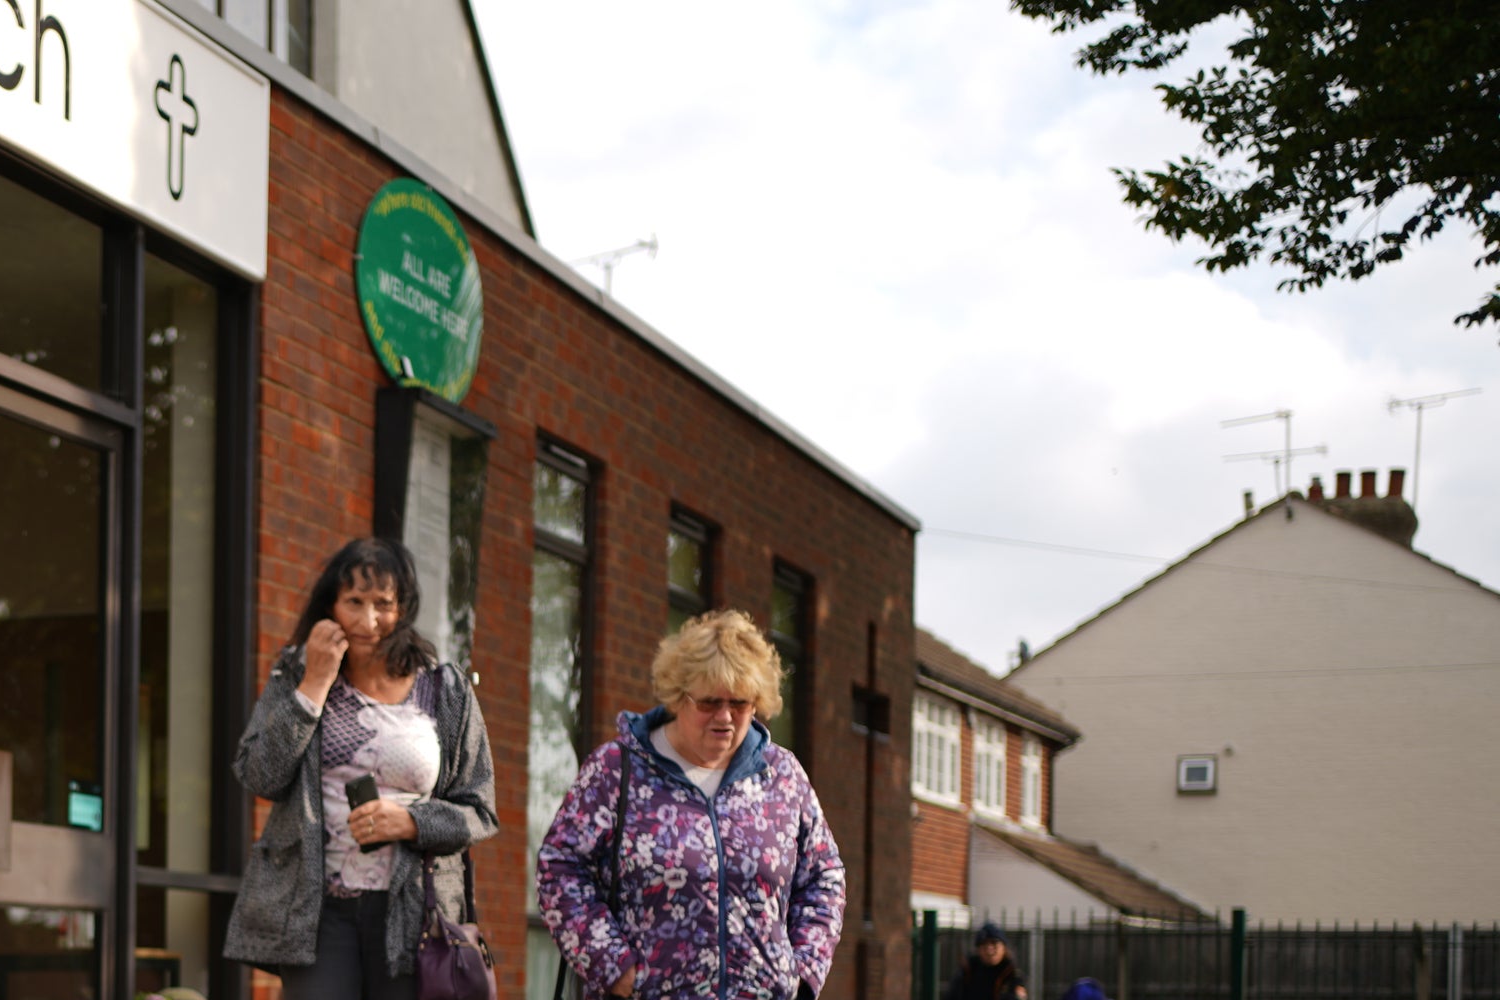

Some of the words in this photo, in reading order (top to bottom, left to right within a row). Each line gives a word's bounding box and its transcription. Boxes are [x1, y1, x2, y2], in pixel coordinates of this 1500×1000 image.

[378, 267, 439, 323] WELCOME
[441, 306, 467, 341] HERE
[401, 249, 426, 282] ALL
[427, 265, 451, 298] ARE
